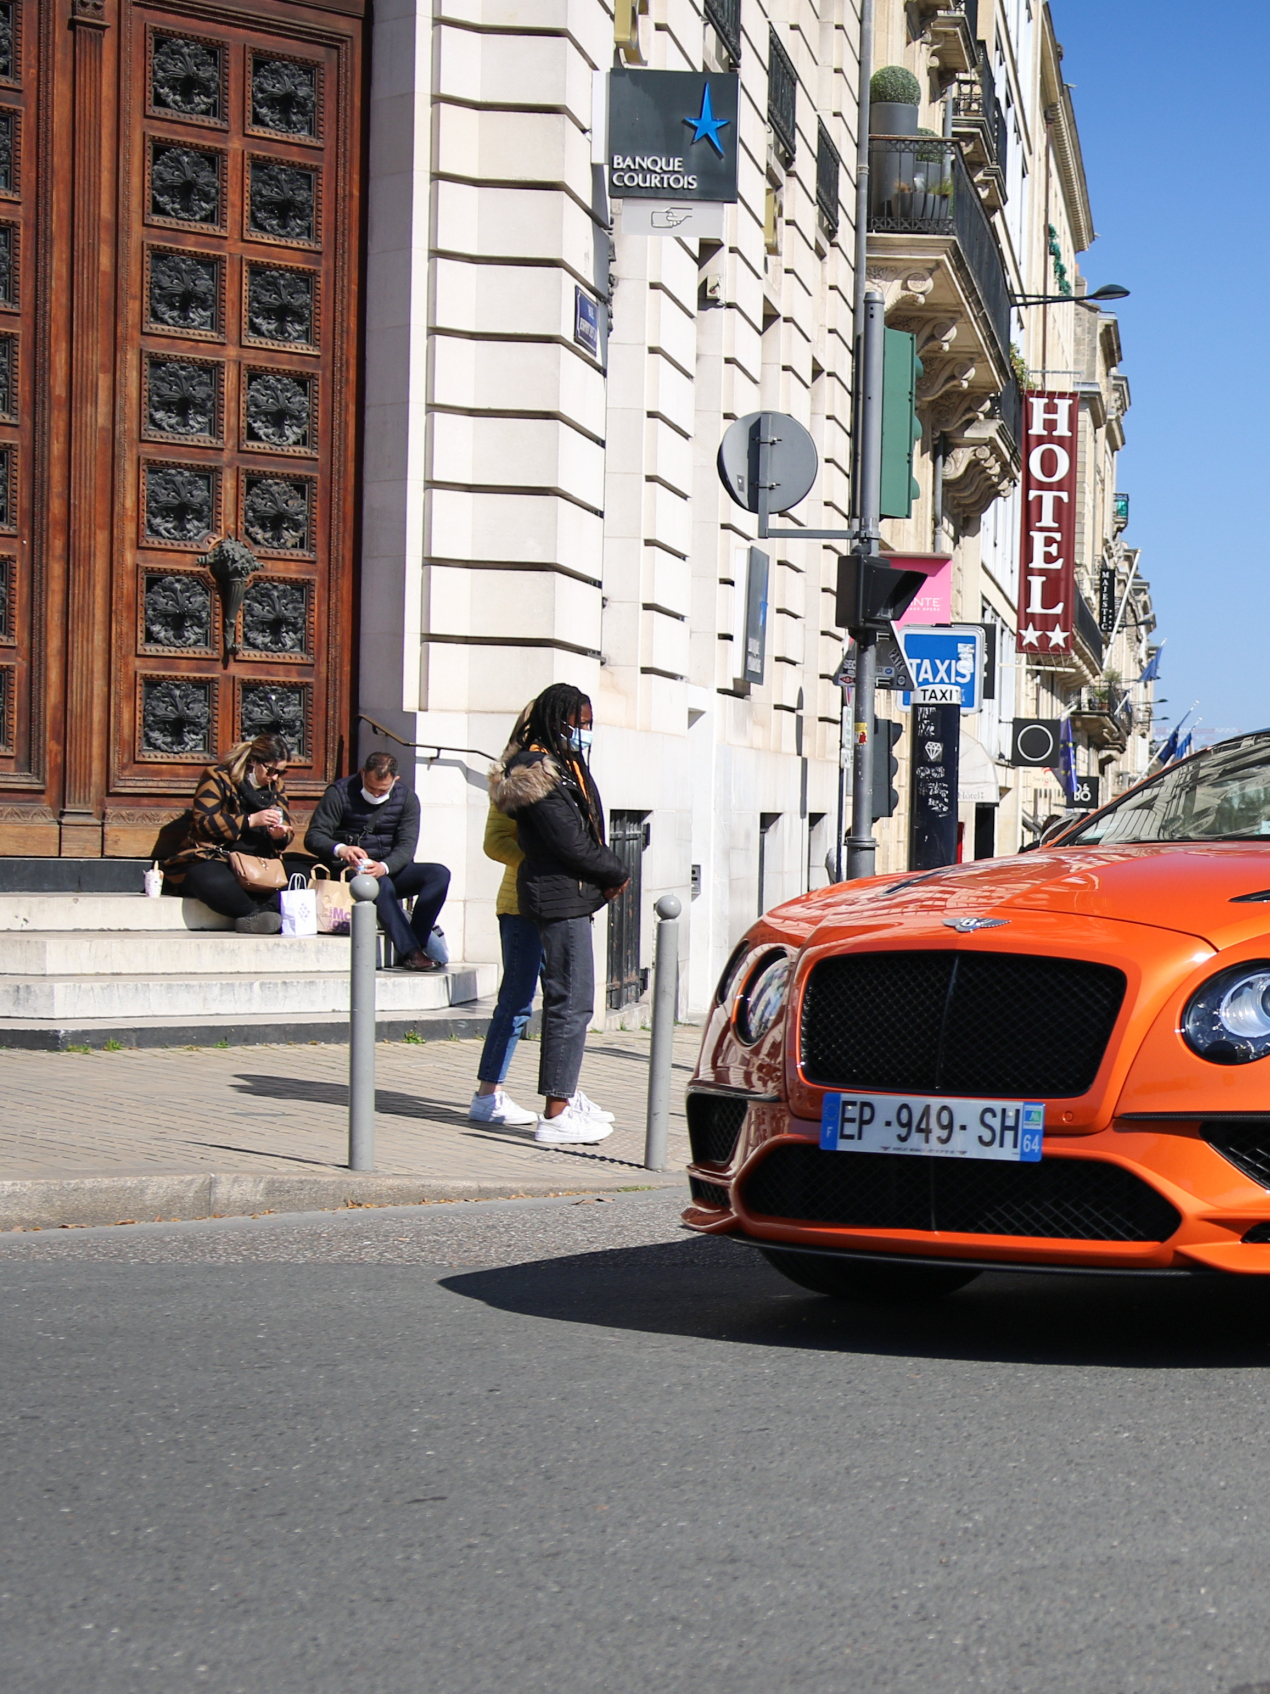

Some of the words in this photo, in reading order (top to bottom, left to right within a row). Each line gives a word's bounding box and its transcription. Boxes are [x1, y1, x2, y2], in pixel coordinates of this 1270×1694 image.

[613, 154, 684, 173] BANQUE
[612, 171, 698, 189] COURTOIS
[1026, 397, 1074, 615] HOTEL
[910, 597, 941, 607] NTE
[1101, 571, 1110, 630] MAJESTIC
[908, 658, 972, 684] TAXIS
[920, 689, 953, 702] TAXI
[1023, 1134, 1040, 1153] 64
